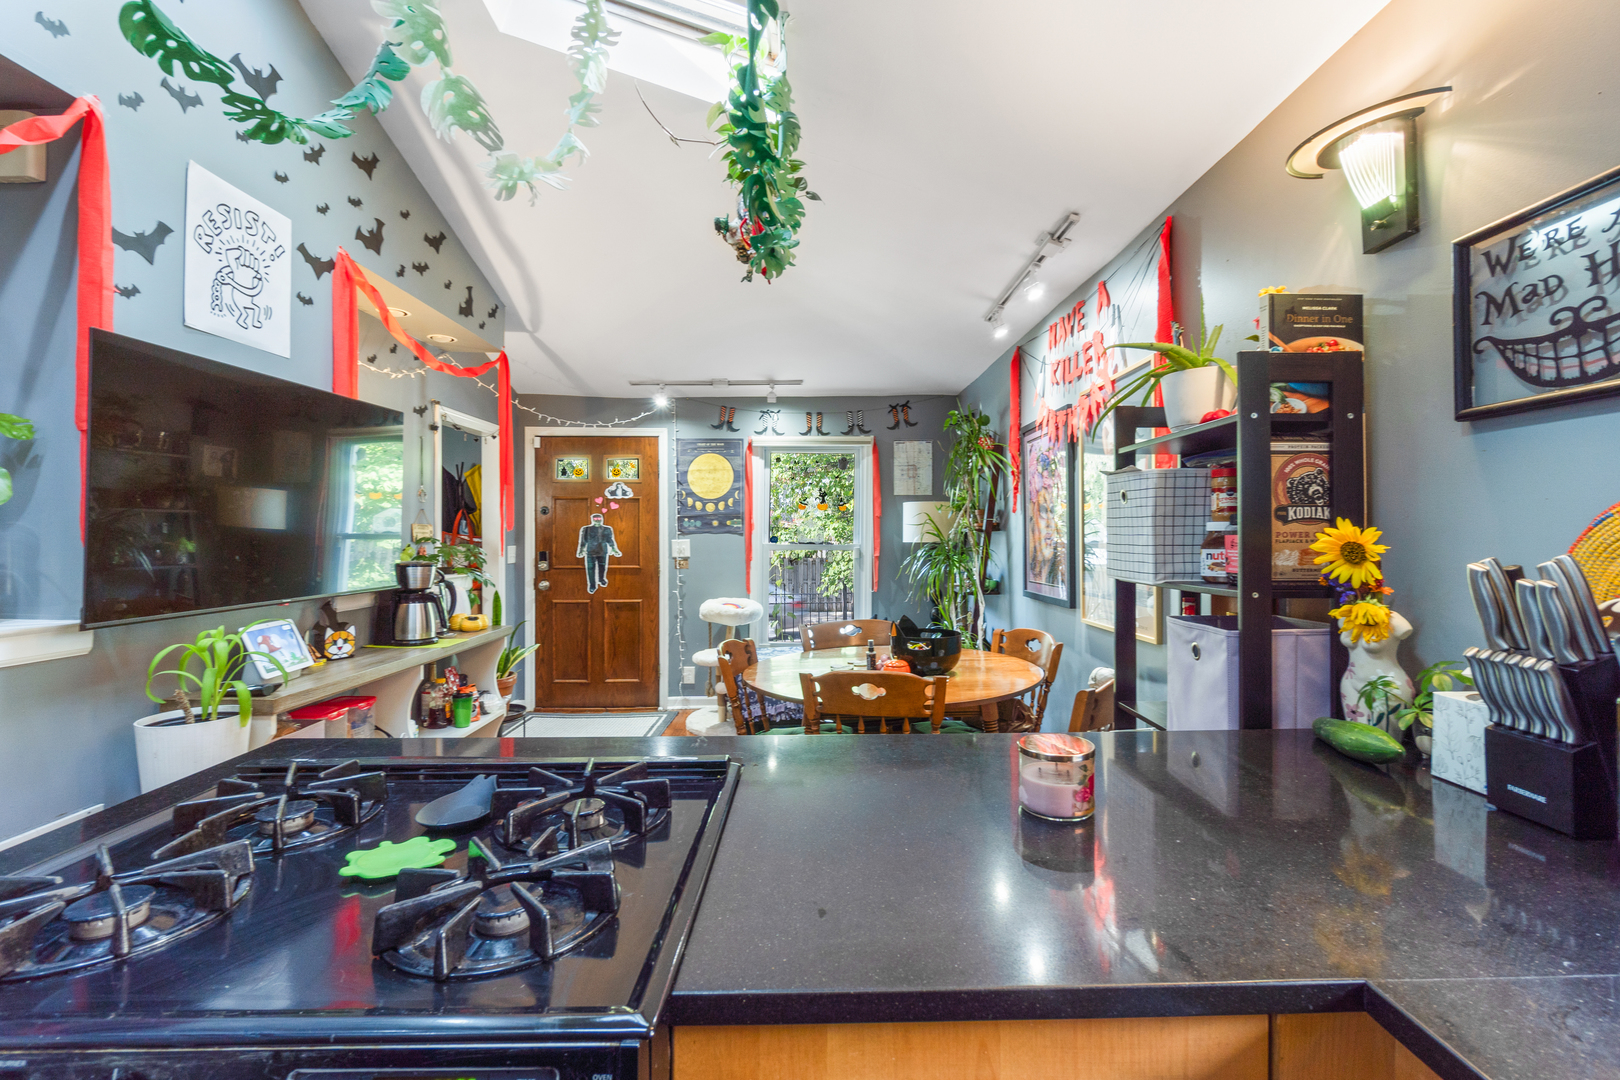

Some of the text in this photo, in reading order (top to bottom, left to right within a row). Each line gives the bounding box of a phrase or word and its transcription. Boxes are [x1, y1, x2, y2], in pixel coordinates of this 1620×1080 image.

[193, 203, 286, 262] RESIST!
[1048, 280, 1111, 351] HAVE A
[1286, 313, 1354, 324] Dinner in One
[1051, 330, 1107, 387] KILLER
